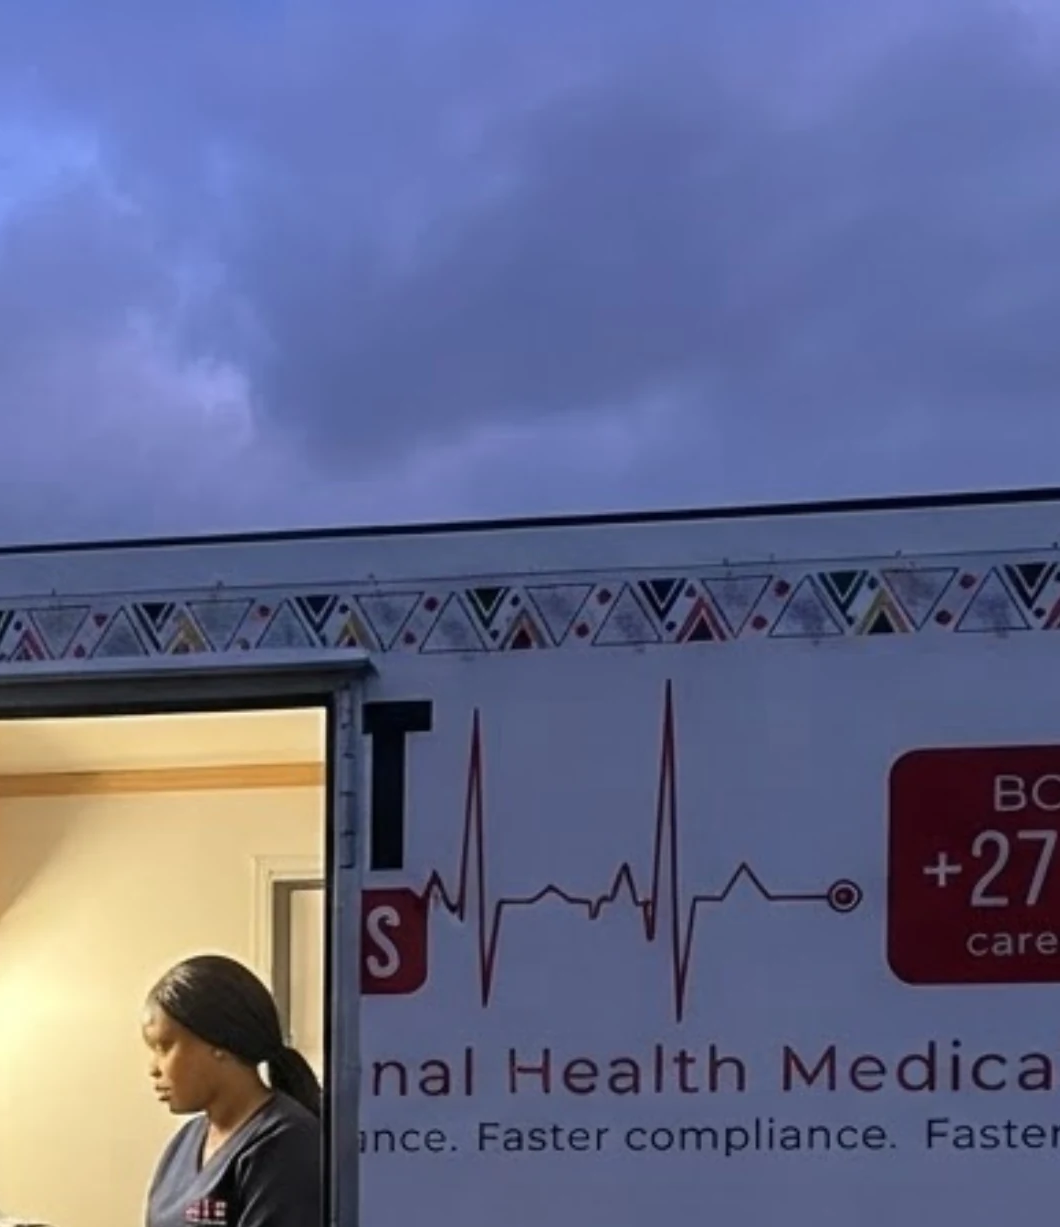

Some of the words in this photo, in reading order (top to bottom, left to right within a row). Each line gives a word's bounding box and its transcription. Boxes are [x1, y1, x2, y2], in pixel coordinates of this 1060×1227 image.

[922, 829, 1059, 908] +27
[366, 905, 401, 979] S
[966, 931, 1059, 957] care
[372, 1046, 473, 1097] nal
[509, 1044, 746, 1095] Health
[782, 1040, 1053, 1093] Medica
[478, 1121, 609, 1152] Faster
[625, 1117, 896, 1157] compliance.
